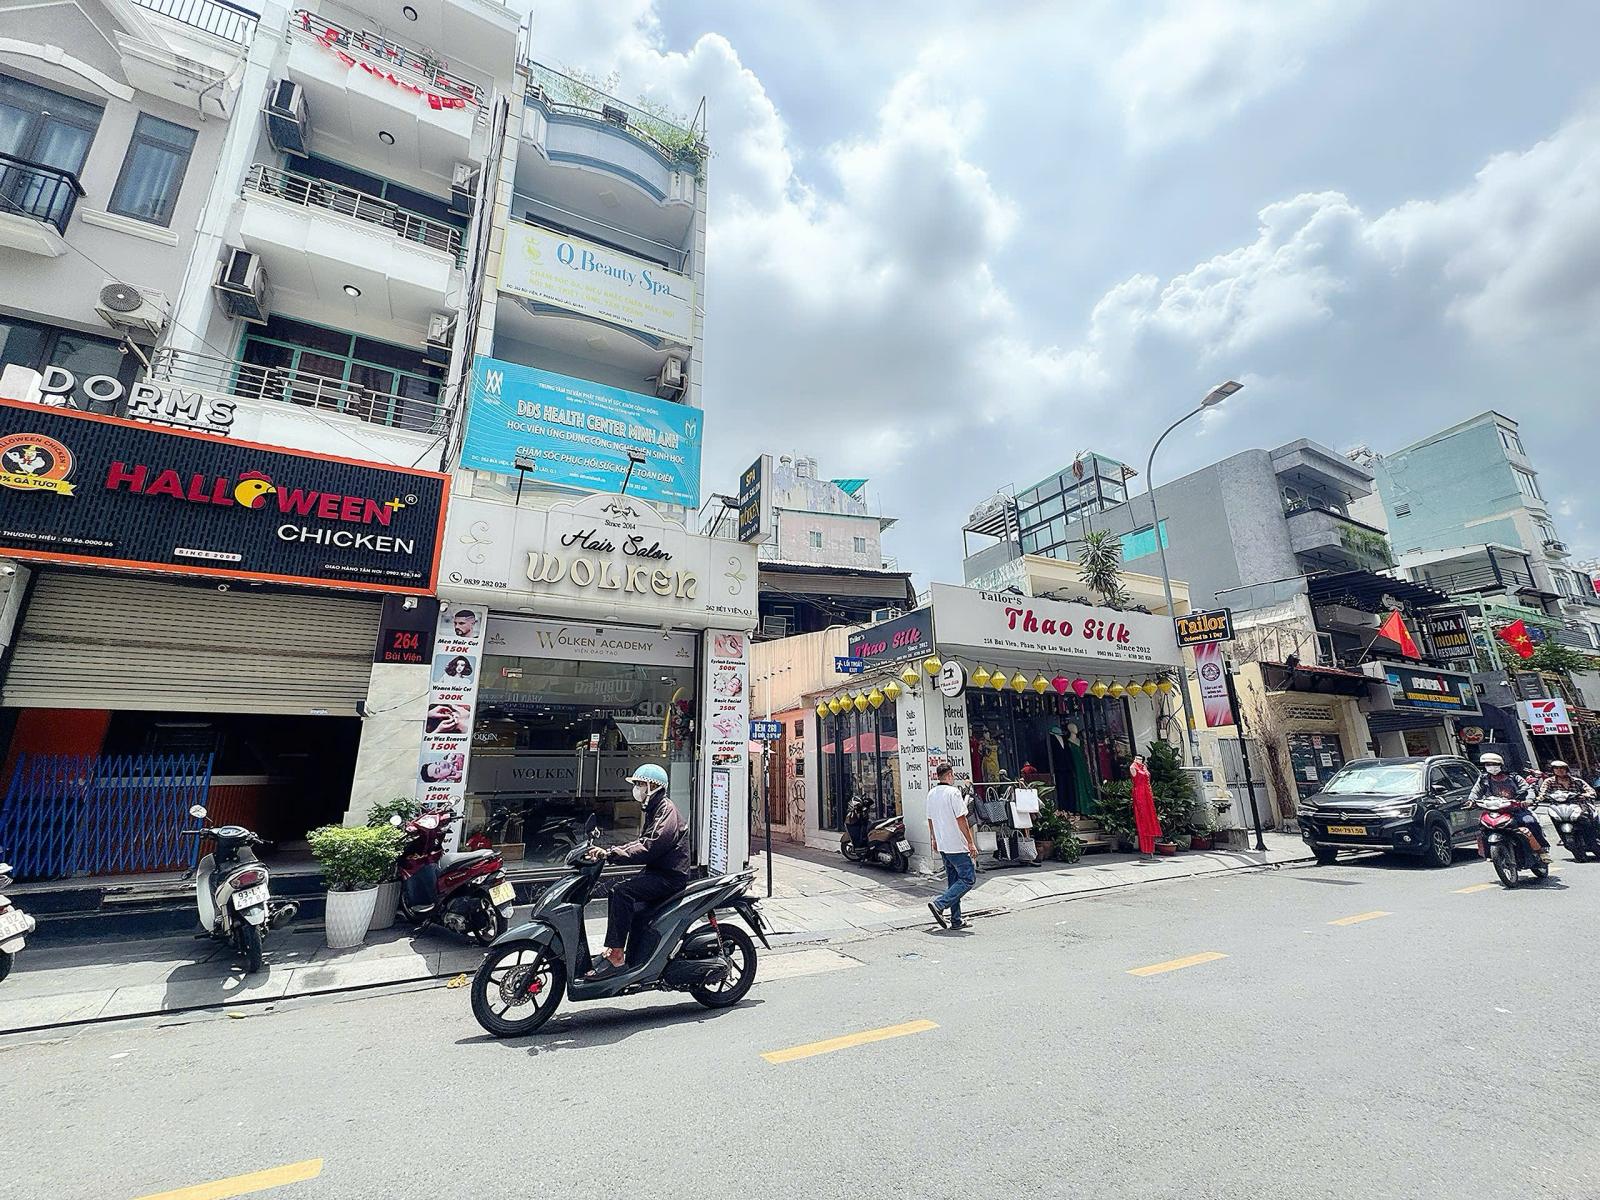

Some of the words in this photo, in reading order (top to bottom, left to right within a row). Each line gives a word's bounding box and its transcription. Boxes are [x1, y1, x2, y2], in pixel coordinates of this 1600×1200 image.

[582, 250, 636, 286] Beauty
[640, 269, 670, 296] Spa
[39, 365, 237, 427] DORMS
[517, 399, 541, 419] DDS
[543, 405, 585, 429] HEALTH
[586, 414, 627, 438] CENTER
[628, 423, 656, 444] MINH
[656, 432, 679, 450] ANH
[652, 450, 669, 461] SINH
[14, 477, 30, 485] GÀ
[604, 518, 622, 530] Since
[622, 520, 637, 531] 2014
[277, 523, 415, 555] CHICKEN
[561, 528, 616, 554] Hair
[622, 533, 674, 563] Salon
[178, 549, 211, 559] SINCE
[463, 577, 481, 586] 0839
[481, 579, 494, 588] 282
[494, 581, 507, 589] 028
[705, 604, 715, 612] 262
[1004, 607, 1073, 637] Thao
[1082, 618, 1131, 644] Silk
[1177, 614, 1226, 636] Tailor
[1431, 619, 1457, 633] PAPA
[393, 632, 419, 650] 264
[536, 627, 596, 650] WOLKEN
[600, 639, 654, 652] ACADEMY
[855, 641, 888, 658] Thao
[892, 627, 922, 649] Silk
[1183, 634, 1202, 642] Ordered
[1434, 632, 1468, 648] INDIAN
[444, 645, 470, 653] 150K
[1020, 641, 1035, 649] Pham
[1116, 643, 1136, 652] Since
[1136, 645, 1151, 654] 2012
[1437, 645, 1472, 658] RESTAURANT
[385, 650, 400, 661] Bùi
[402, 650, 423, 663] Viện
[905, 709, 916, 720] Suits
[945, 705, 964, 719] rdered
[471, 731, 499, 742] OLKEN
[953, 725, 964, 739] day
[430, 743, 459, 751] 150K
[900, 745, 911, 756] Party
[511, 767, 577, 780] WOLKEN
[906, 762, 922, 772] Dresses
[425, 793, 450, 801] 150K
